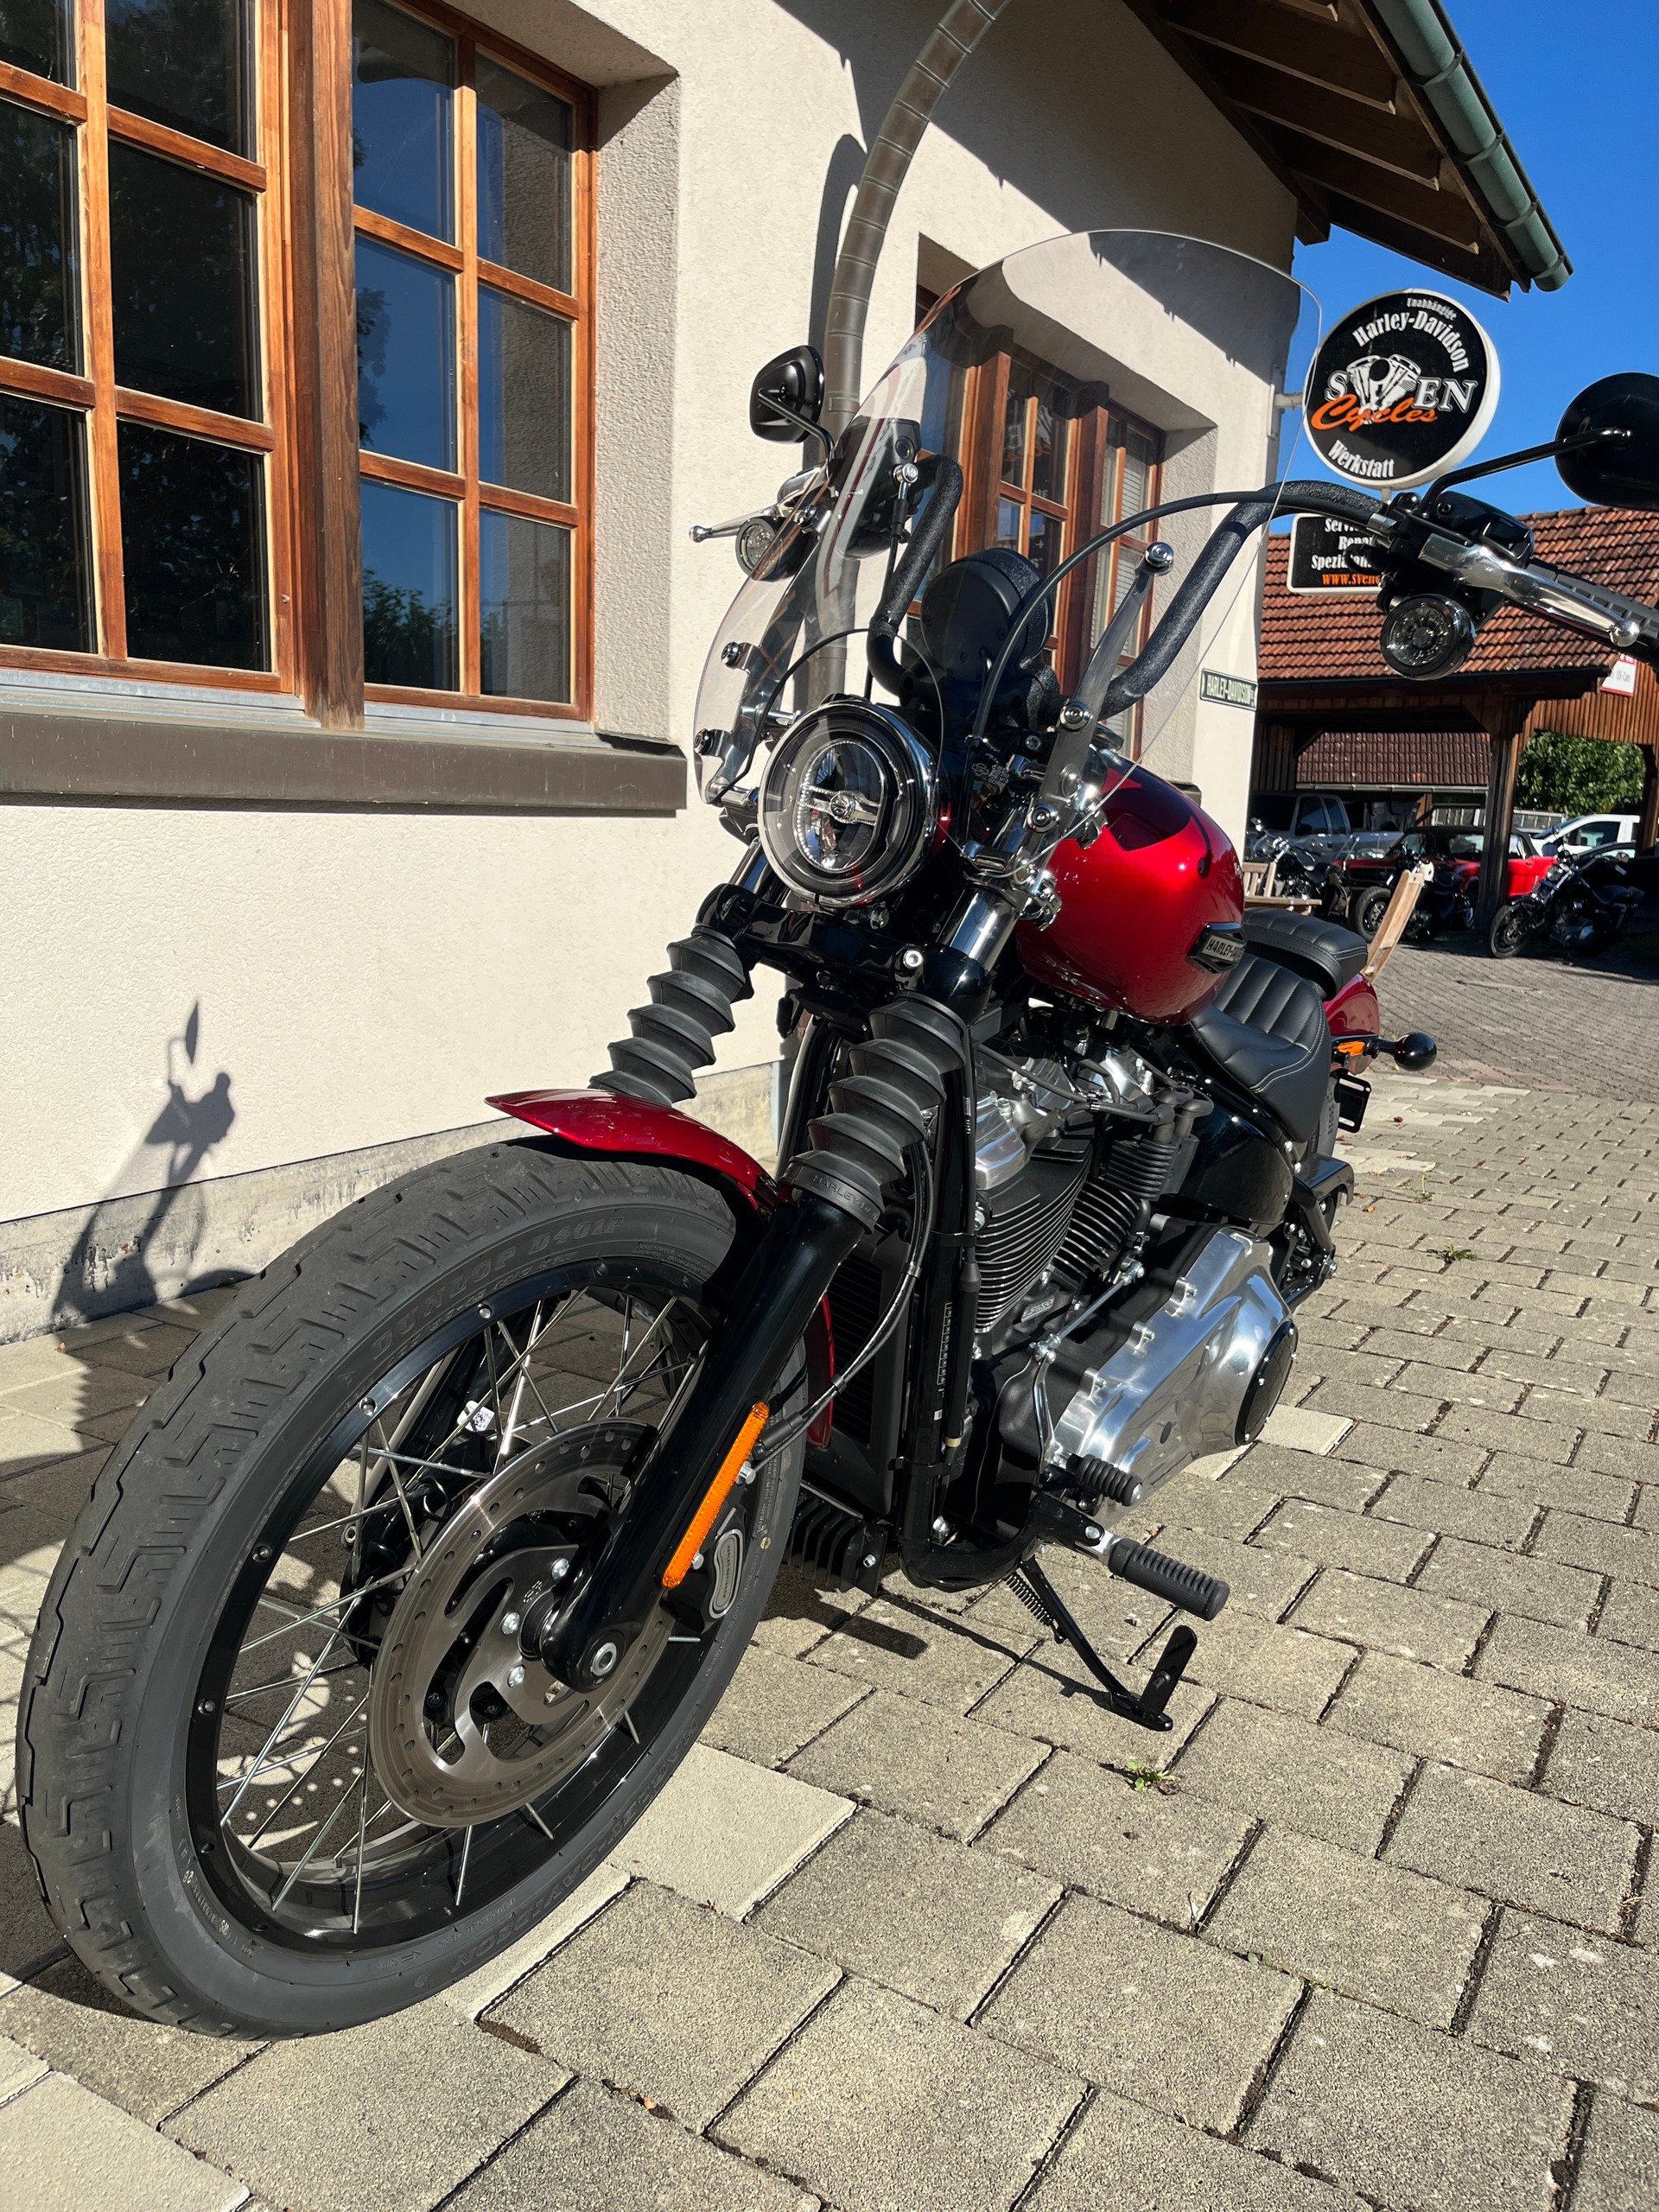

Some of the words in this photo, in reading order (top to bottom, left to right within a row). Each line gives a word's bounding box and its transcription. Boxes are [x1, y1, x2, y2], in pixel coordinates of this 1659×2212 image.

[1352, 310, 1469, 373] Harley-Davidson
[1311, 393, 1438, 432] Cycles
[1328, 440, 1395, 478] Werkstatt
[528, 1216, 625, 1255] D401F
